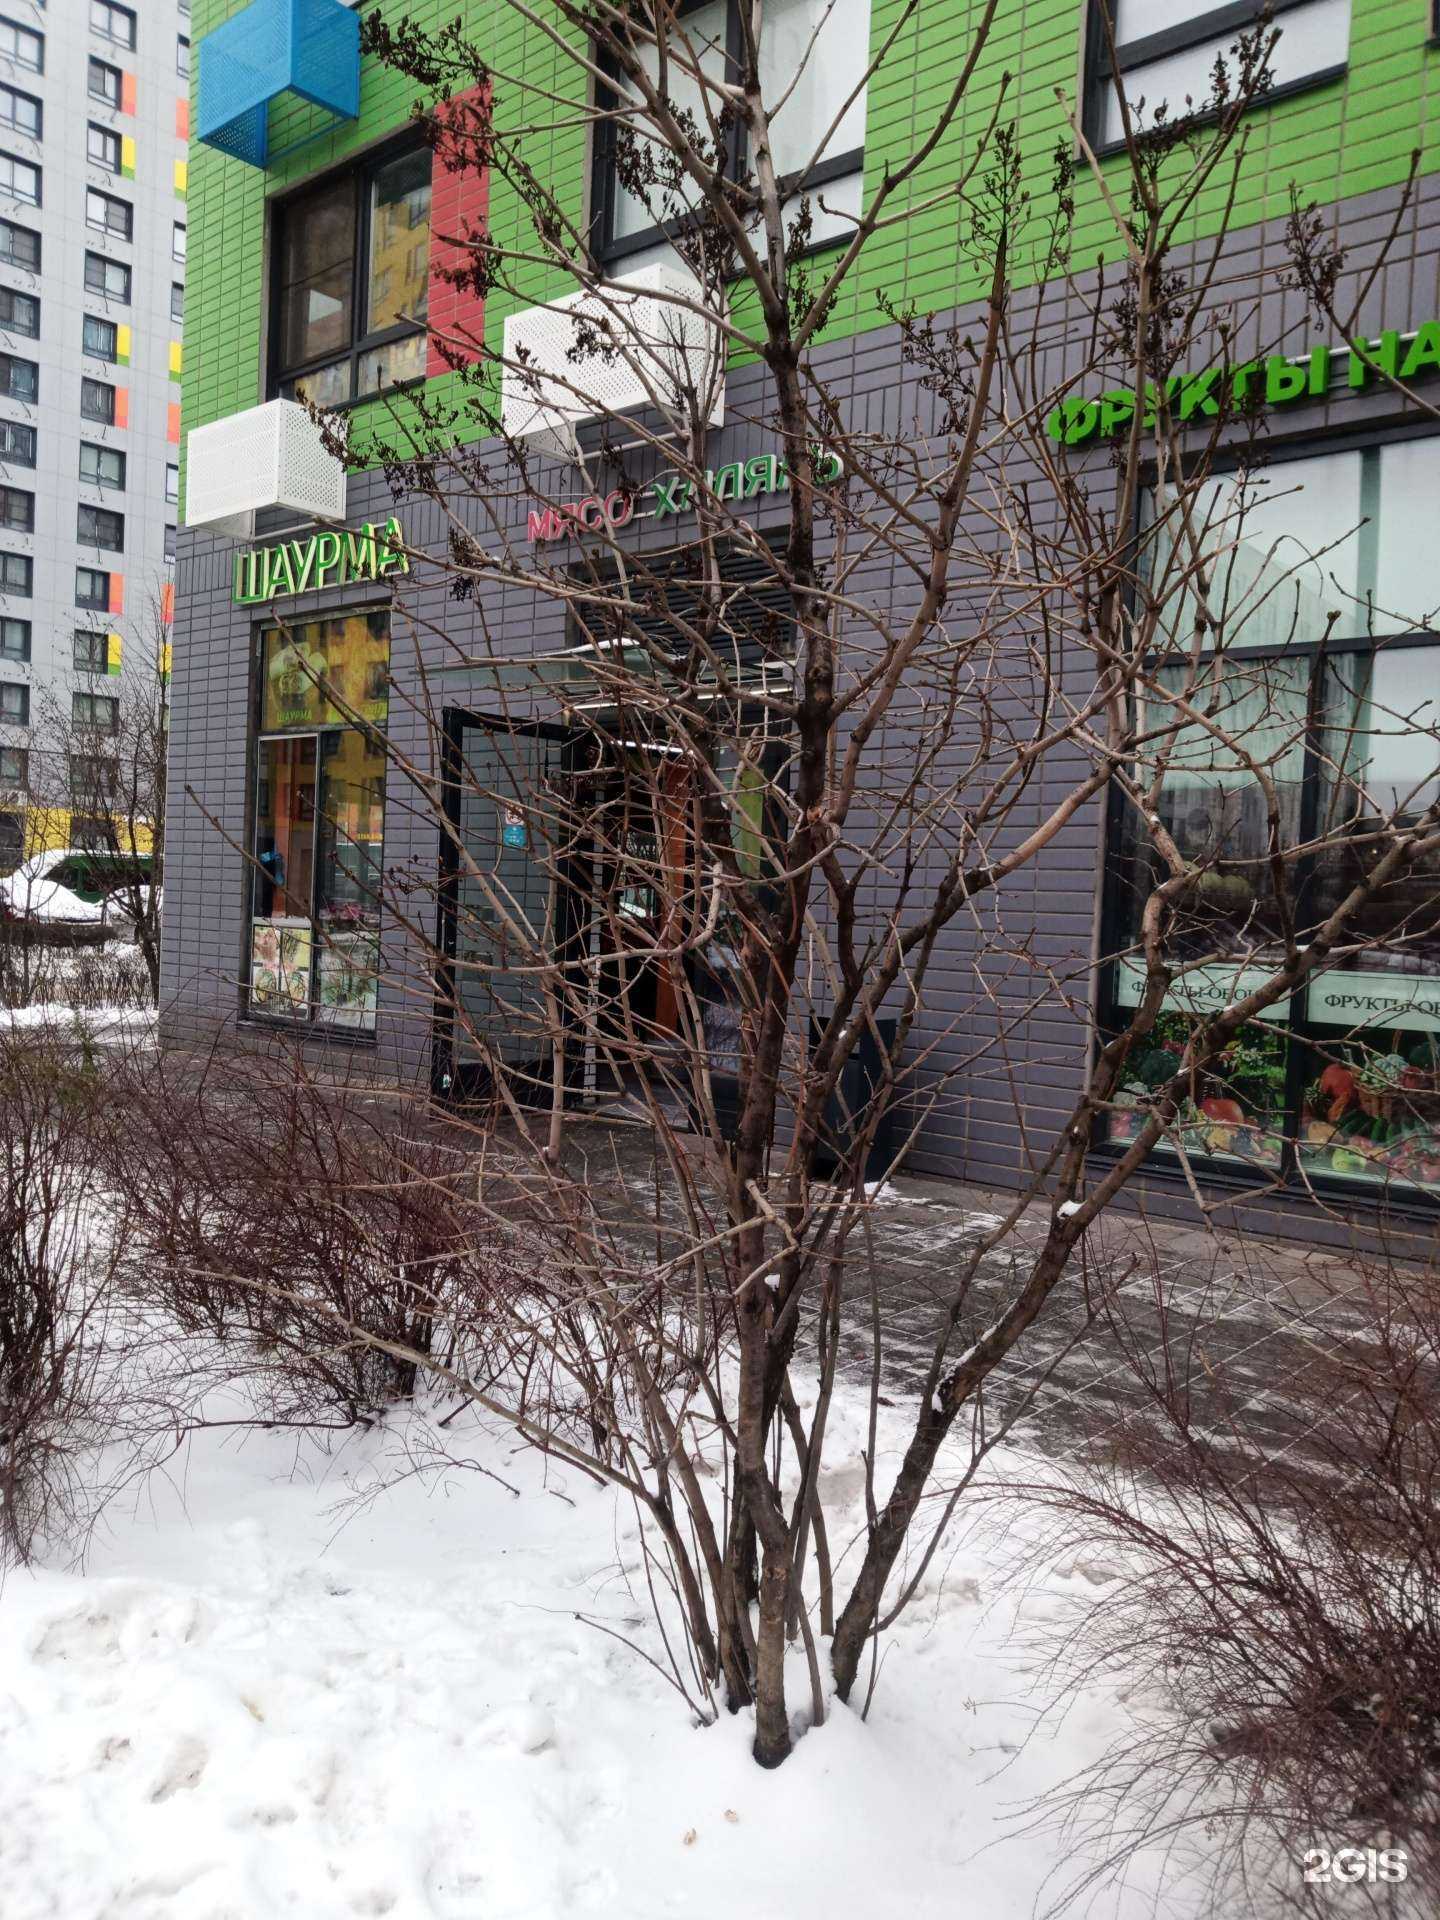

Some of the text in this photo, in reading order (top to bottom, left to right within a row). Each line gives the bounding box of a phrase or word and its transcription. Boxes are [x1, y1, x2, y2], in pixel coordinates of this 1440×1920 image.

[527, 443, 844, 544] МЯСО ХЛЯЬ
[232, 516, 409, 606] ШАУРМА
